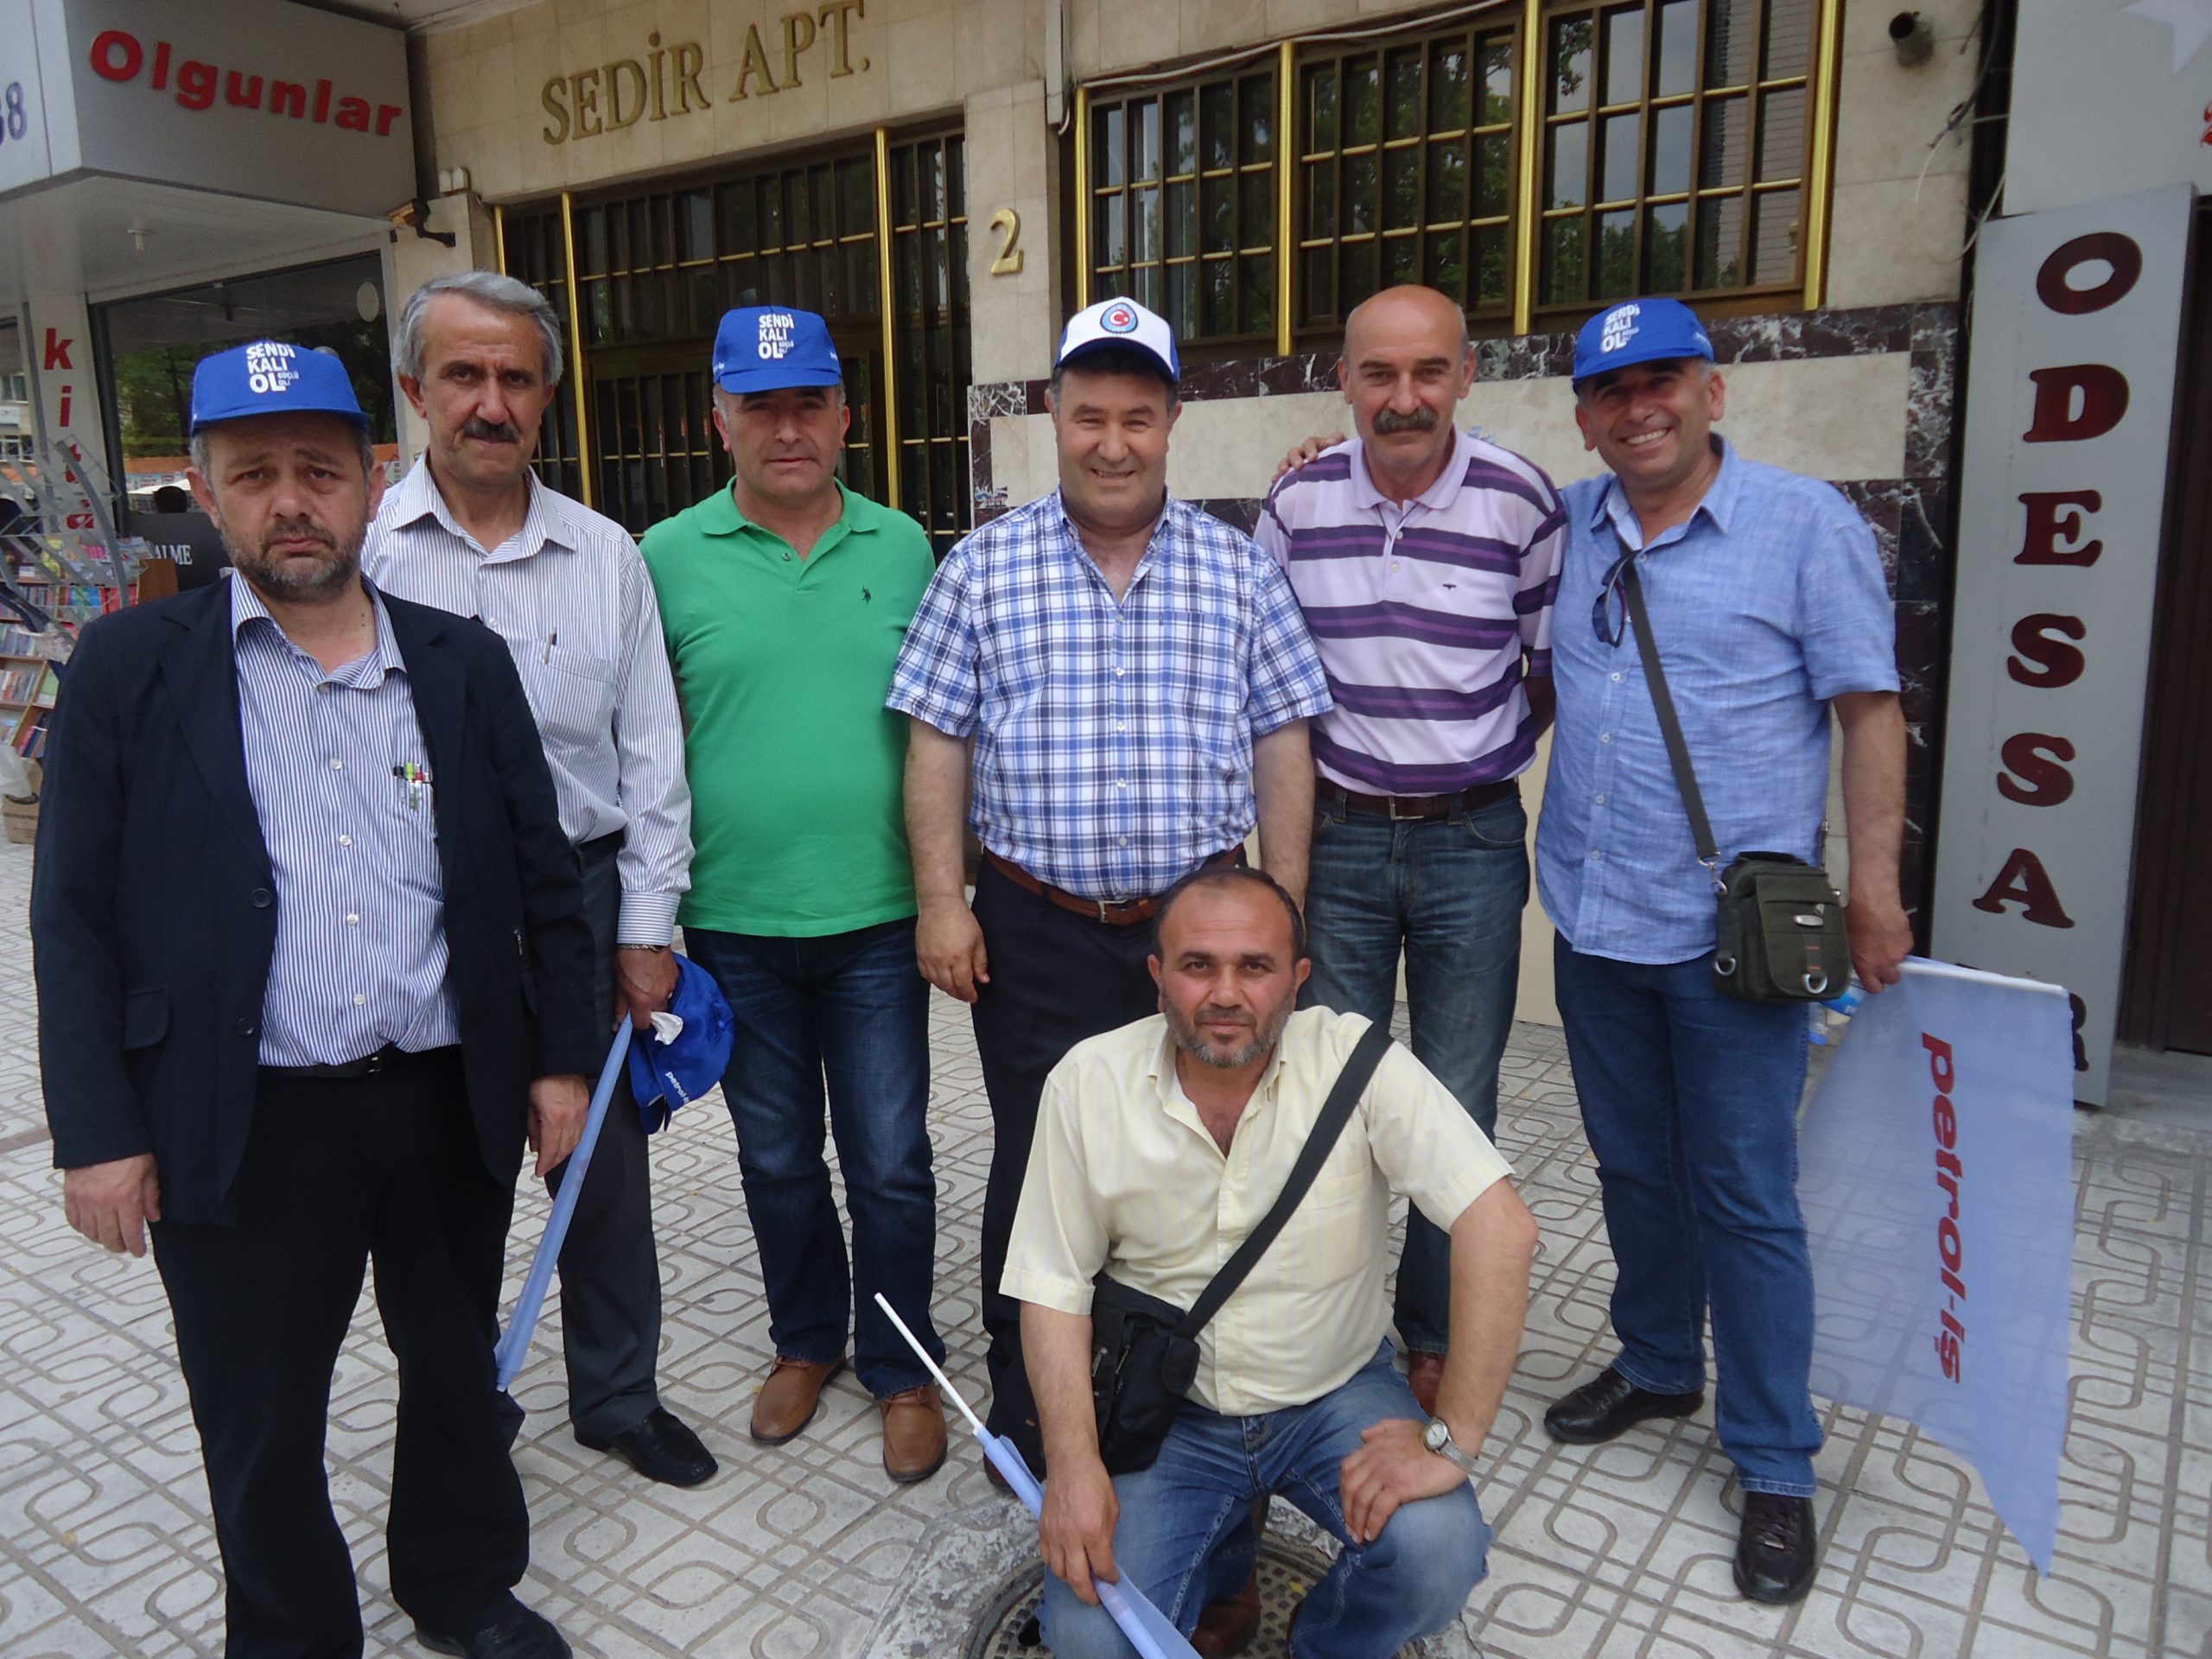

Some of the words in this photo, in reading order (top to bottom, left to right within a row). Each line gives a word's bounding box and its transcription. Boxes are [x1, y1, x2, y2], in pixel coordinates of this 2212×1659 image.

[90, 29, 403, 137] Olgunlar
[540, 31, 712, 145] SEDİR
[728, 0, 870, 102] APT.
[0, 81, 28, 146] 8
[989, 207, 1024, 276] 2
[759, 313, 795, 329] SENDİ
[1603, 315, 1631, 338] KALI
[759, 327, 787, 342] KALI
[1600, 331, 1627, 353] OL
[758, 341, 784, 359] OL
[247, 357, 288, 374] KALI
[250, 372, 287, 394] OL
[1955, 231, 2143, 1072] ODESSA
